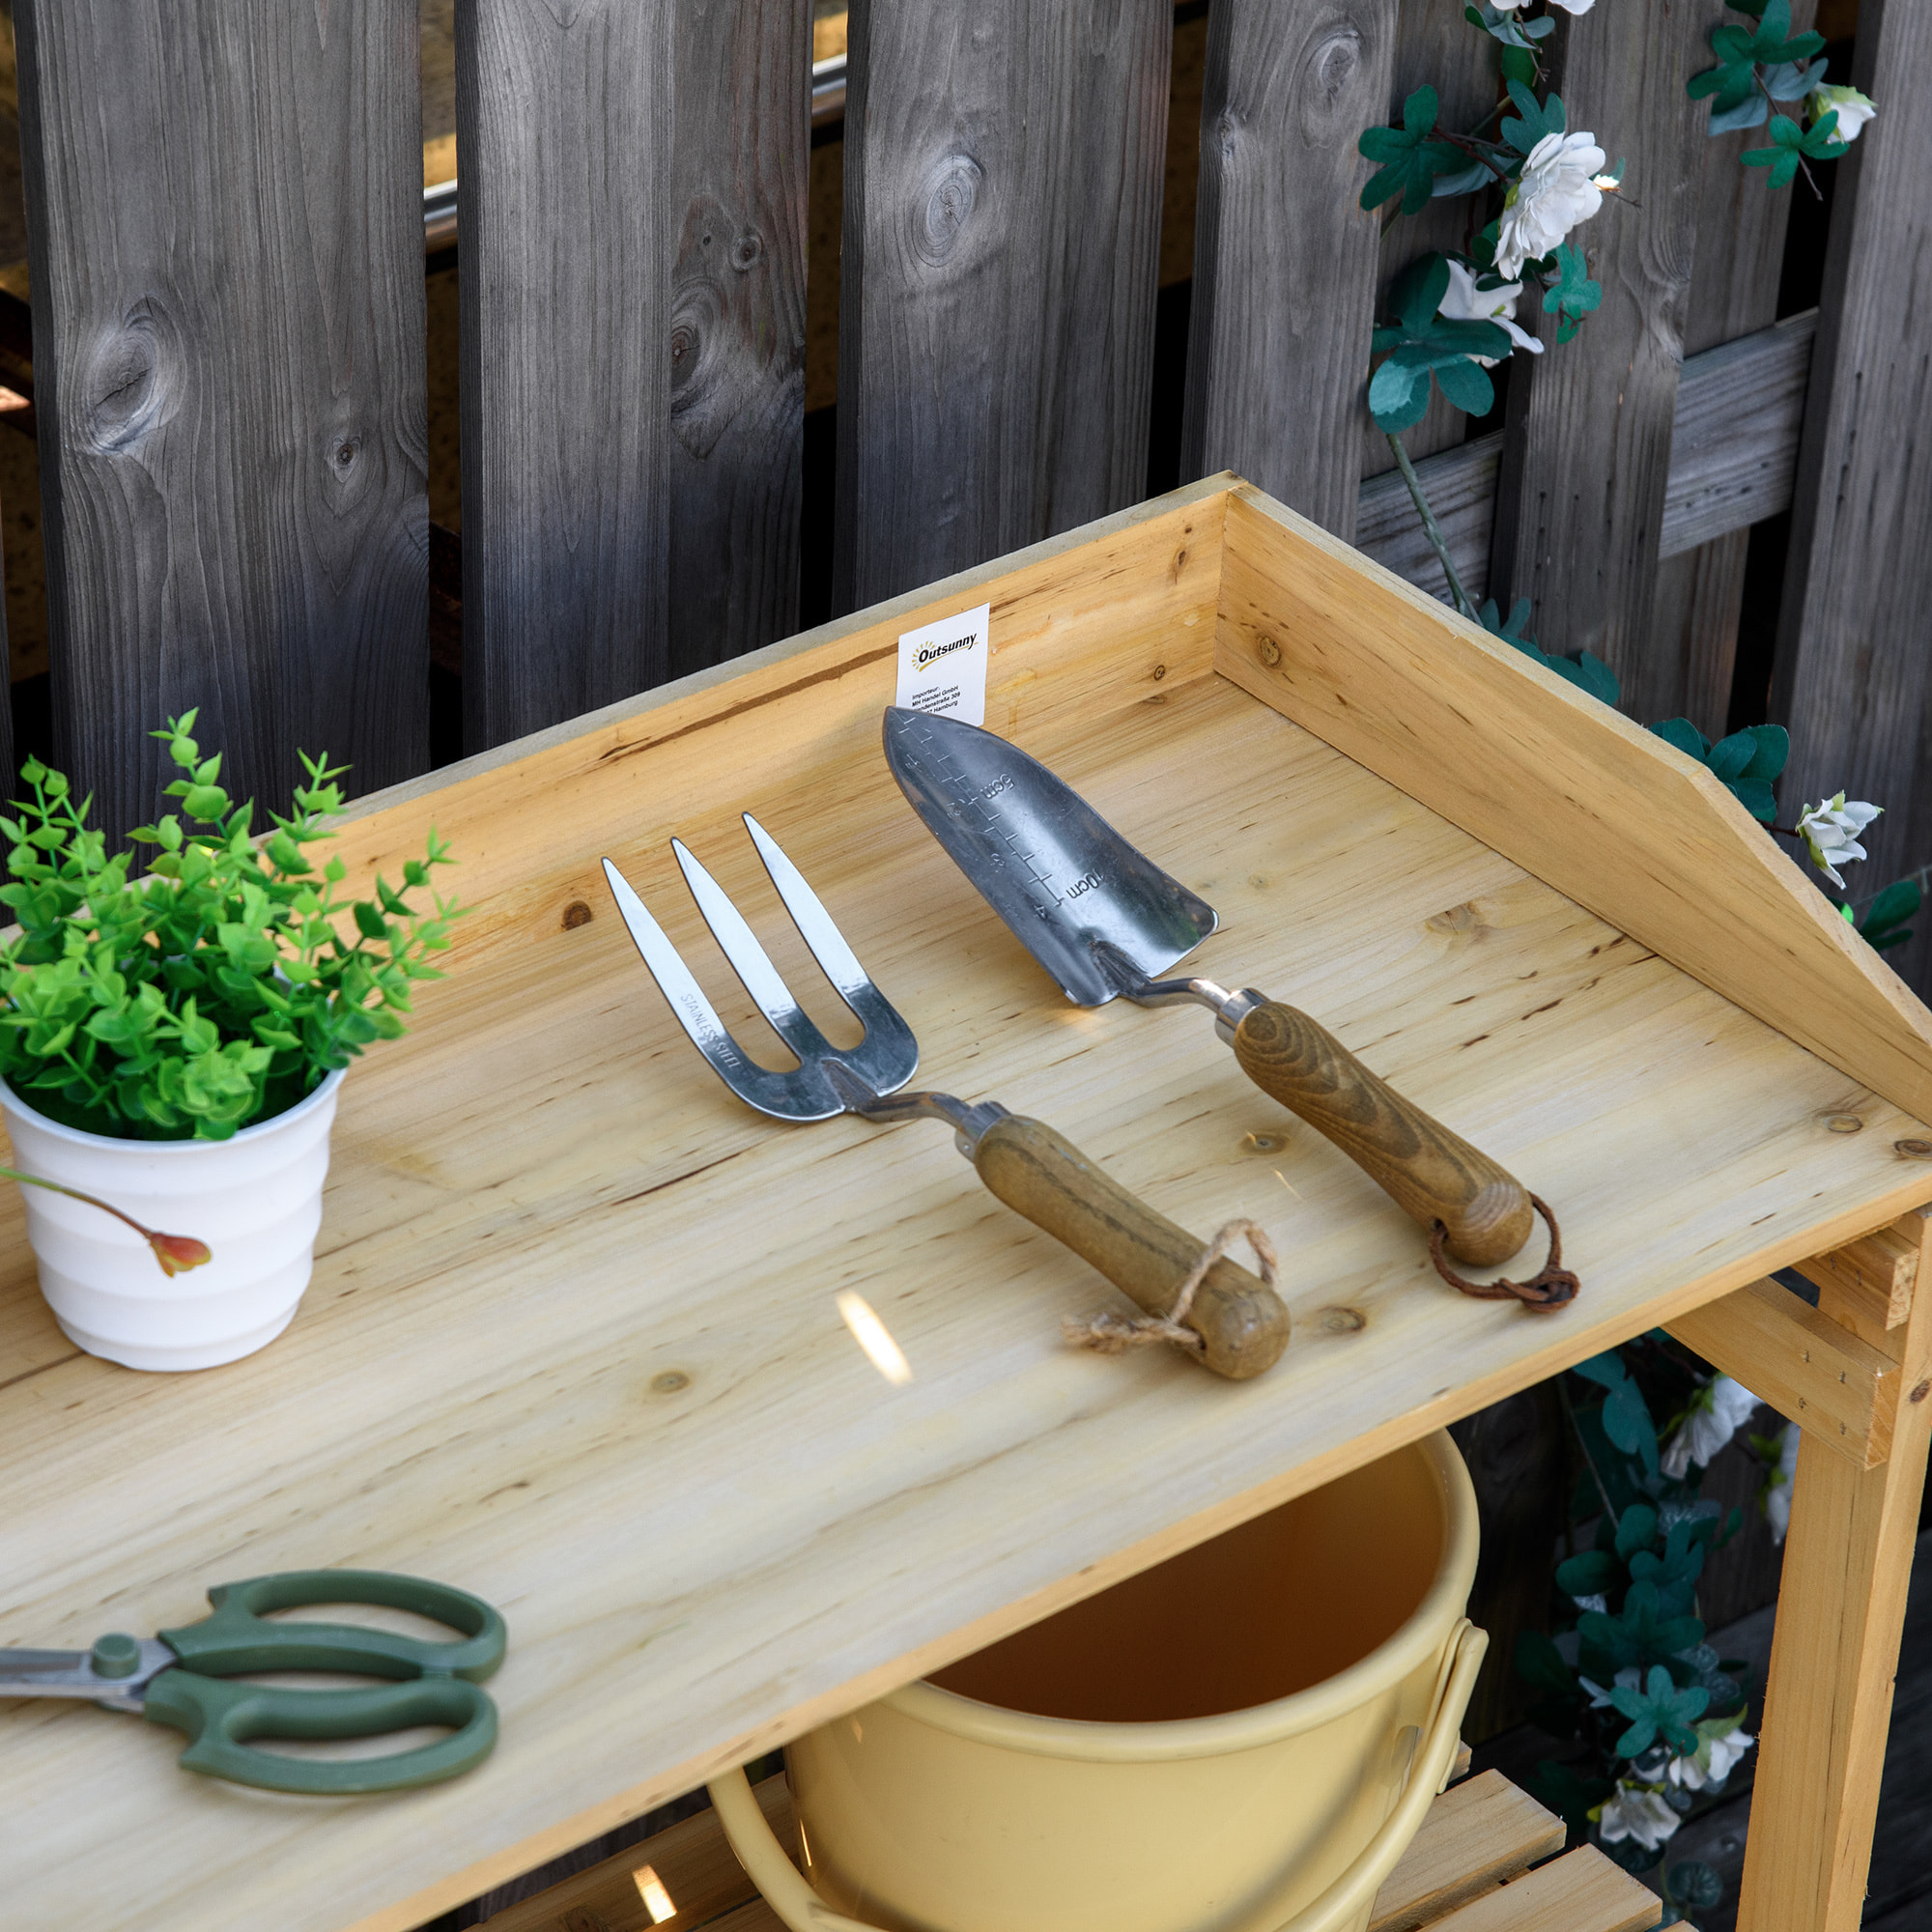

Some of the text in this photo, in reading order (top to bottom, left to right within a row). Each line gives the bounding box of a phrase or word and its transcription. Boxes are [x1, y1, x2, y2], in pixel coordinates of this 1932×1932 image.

[919, 633, 977, 664] Outsunny
[922, 691, 941, 703] Handel
[942, 685, 959, 696] GmbH
[933, 700, 958, 713] Hamburg
[980, 774, 1015, 800] 5cm
[1065, 868, 1105, 899] 10cm
[680, 993, 741, 1068] STAINLESS STEEL
